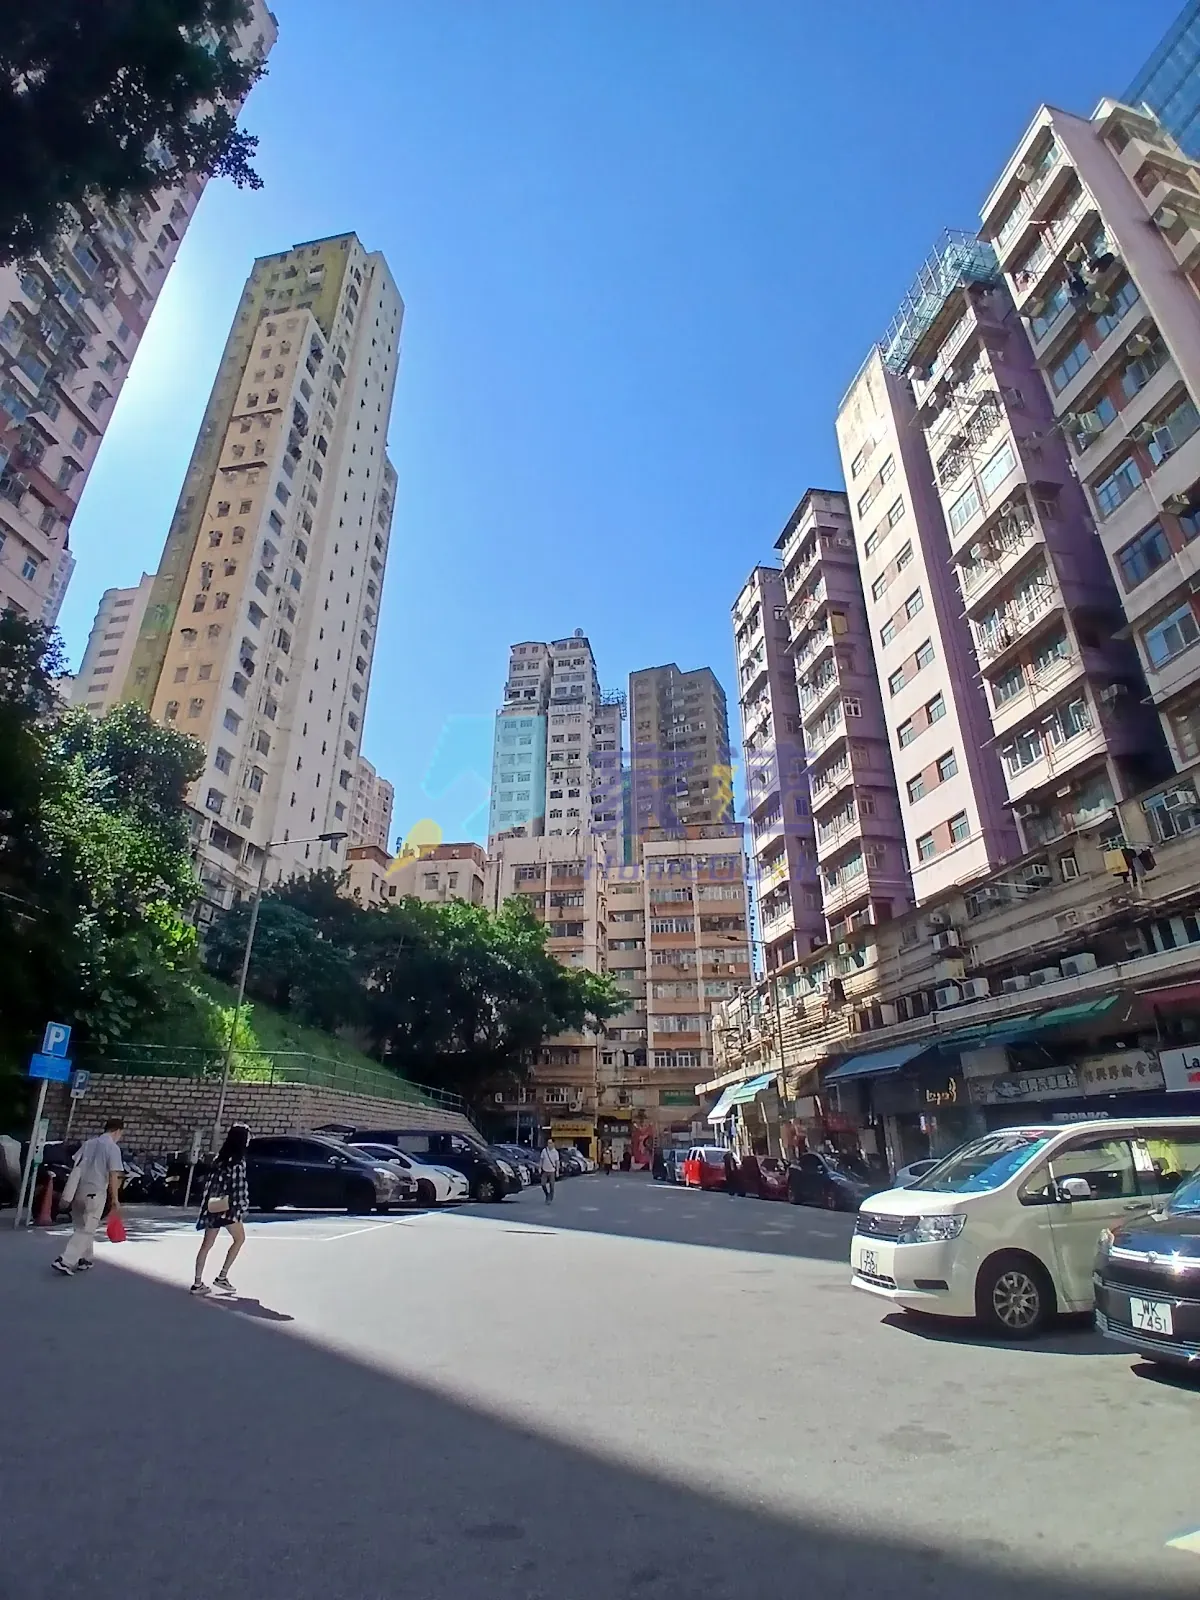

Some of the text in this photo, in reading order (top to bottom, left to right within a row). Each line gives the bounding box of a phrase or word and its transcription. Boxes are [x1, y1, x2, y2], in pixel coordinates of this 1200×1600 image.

[48, 1026, 66, 1051] P
[75, 1072, 86, 1088] P
[1141, 1299, 1159, 1317] WK
[1137, 1313, 1167, 1332] 7451
